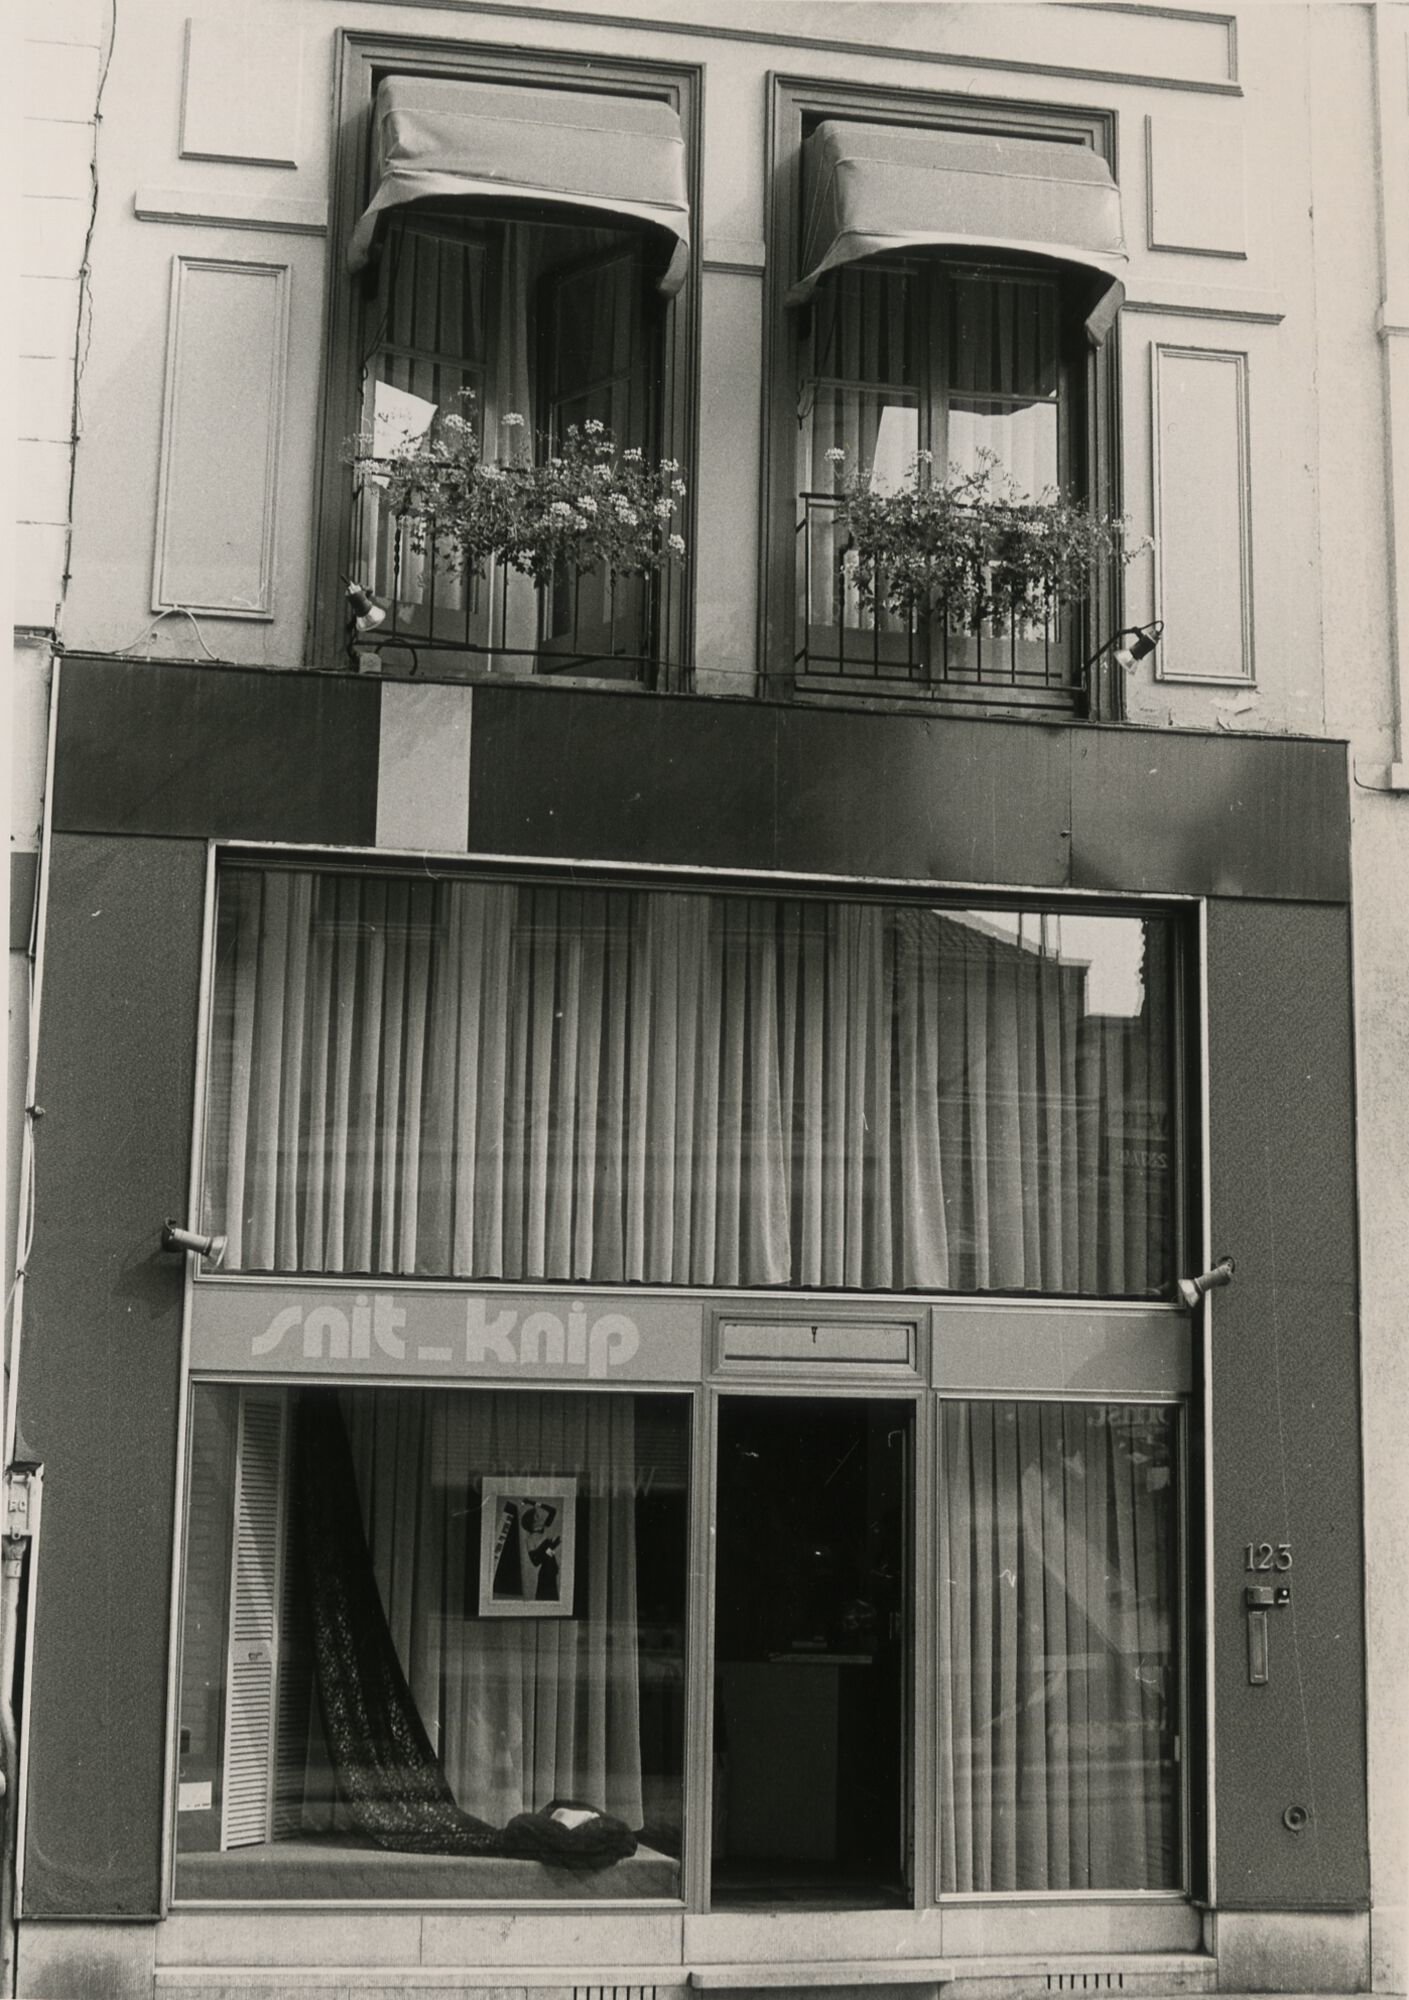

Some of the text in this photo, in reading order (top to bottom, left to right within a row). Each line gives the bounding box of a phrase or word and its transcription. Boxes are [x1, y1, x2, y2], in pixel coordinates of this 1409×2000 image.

[251, 1294, 405, 1360] snit
[466, 1298, 640, 1378] knip
[1246, 1543, 1293, 1571] 123
